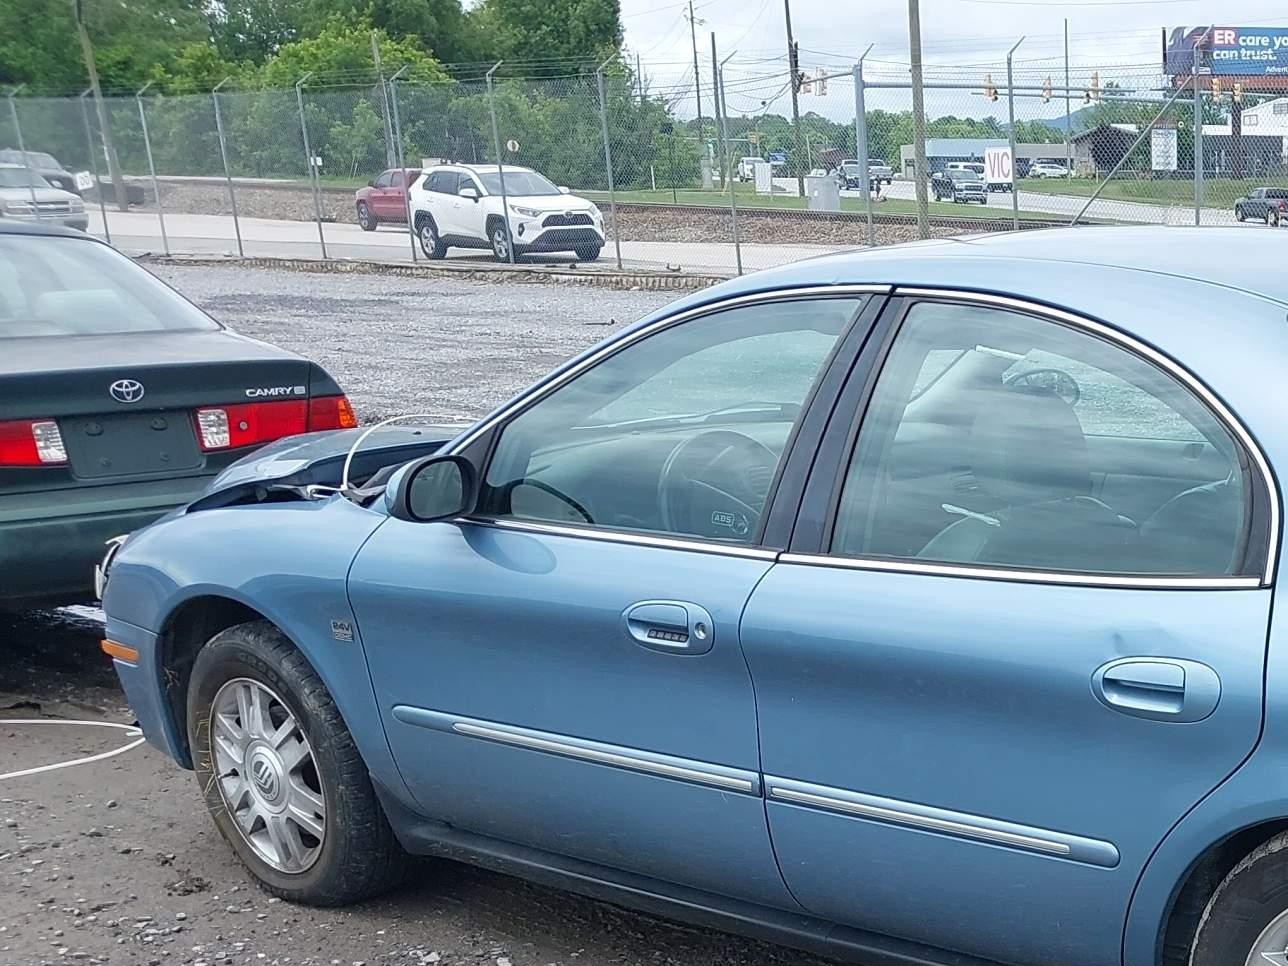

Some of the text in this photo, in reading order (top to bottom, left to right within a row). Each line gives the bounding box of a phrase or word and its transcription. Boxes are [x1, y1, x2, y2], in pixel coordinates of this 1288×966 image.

[1213, 29, 1236, 45] ER
[1238, 35, 1269, 46] care
[1213, 47, 1278, 60] can trust.
[987, 151, 1010, 178] VIC
[245, 386, 293, 397] CAMRY
